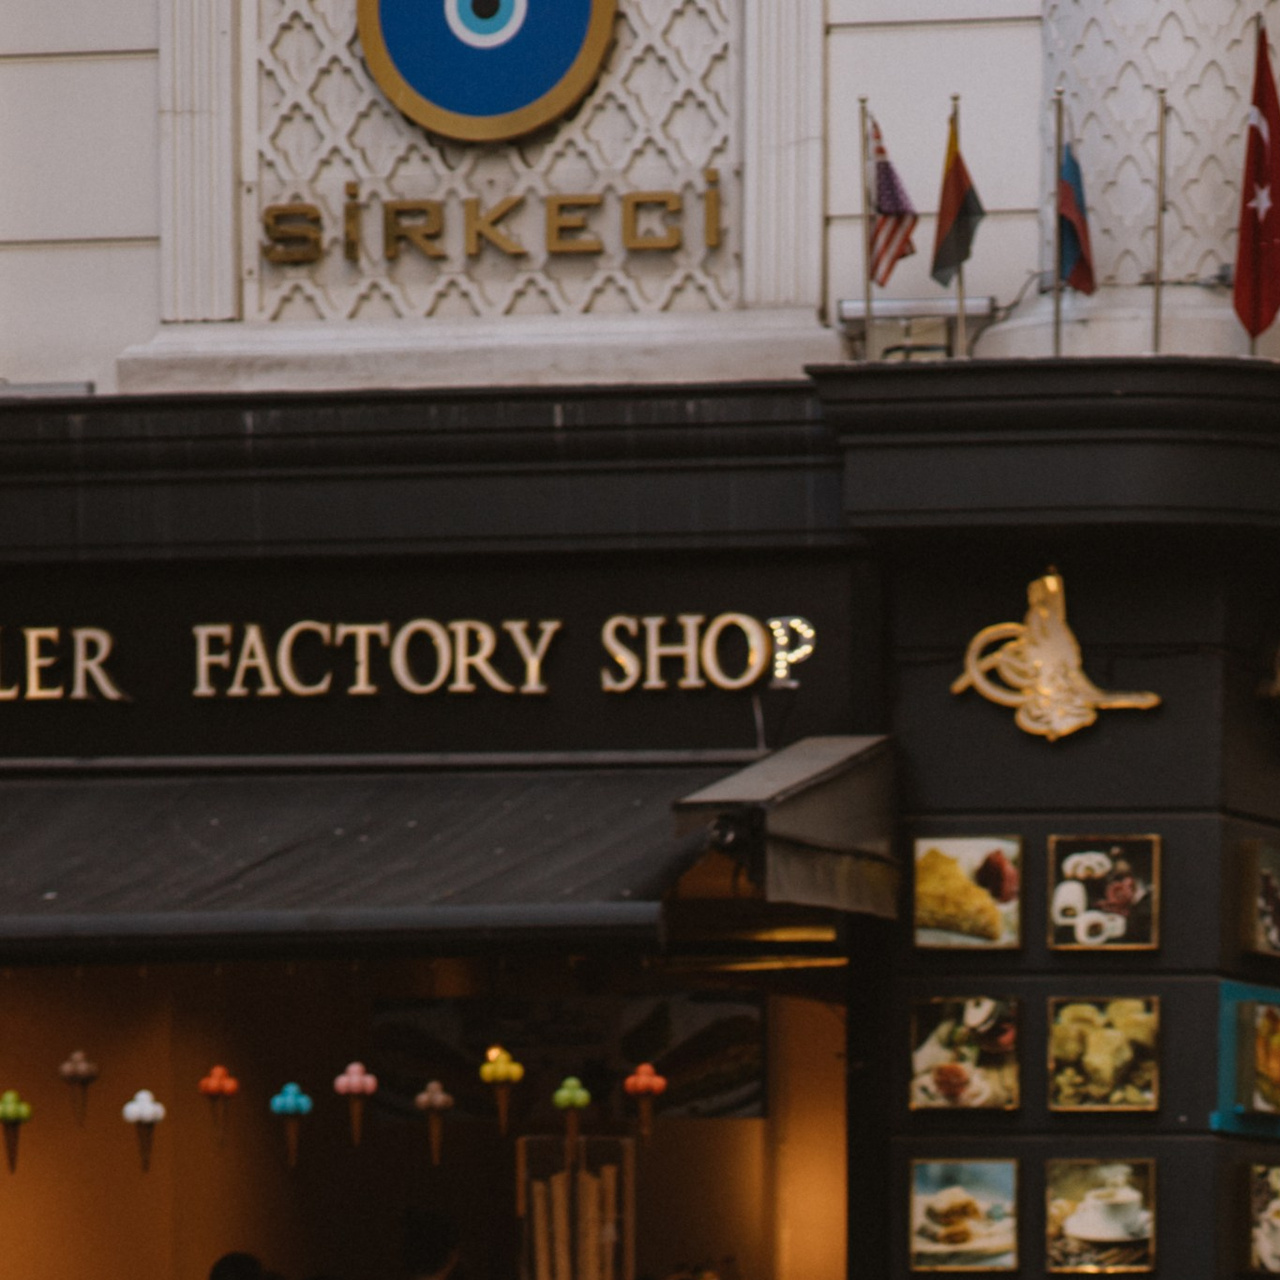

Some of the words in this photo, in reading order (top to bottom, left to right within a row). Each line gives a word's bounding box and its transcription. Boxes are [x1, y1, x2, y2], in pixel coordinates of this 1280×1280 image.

[260, 169, 722, 265] SİRKECİ
[0, 627, 125, 701] ER
[191, 619, 561, 698] FACTORY
[600, 611, 818, 694] SHOP
